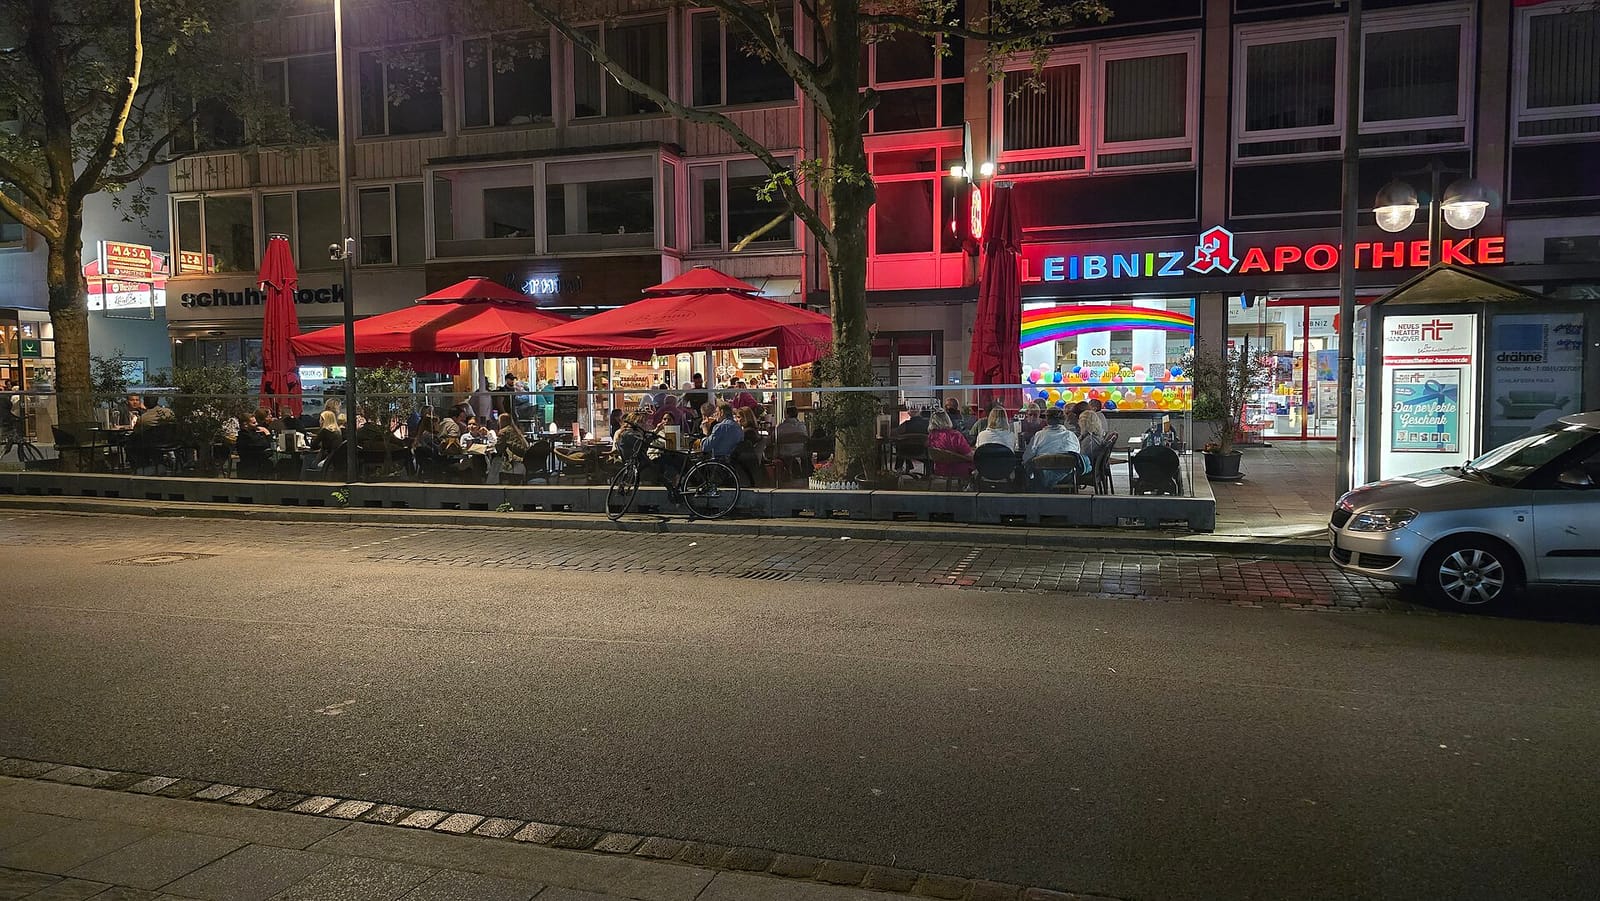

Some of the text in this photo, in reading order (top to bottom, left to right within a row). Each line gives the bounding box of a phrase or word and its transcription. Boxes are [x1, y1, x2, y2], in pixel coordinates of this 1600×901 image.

[111, 246, 146, 258] MASA
[1021, 251, 1184, 282] LEIBNIZ
[1239, 236, 1505, 274] APOTHEKE
[181, 284, 344, 308] schuh-ock
[1091, 348, 1107, 356] CSD
[1496, 352, 1542, 362] drähne
[1393, 401, 1456, 416] Das perfekte
[1400, 413, 1448, 427] Geschenk
